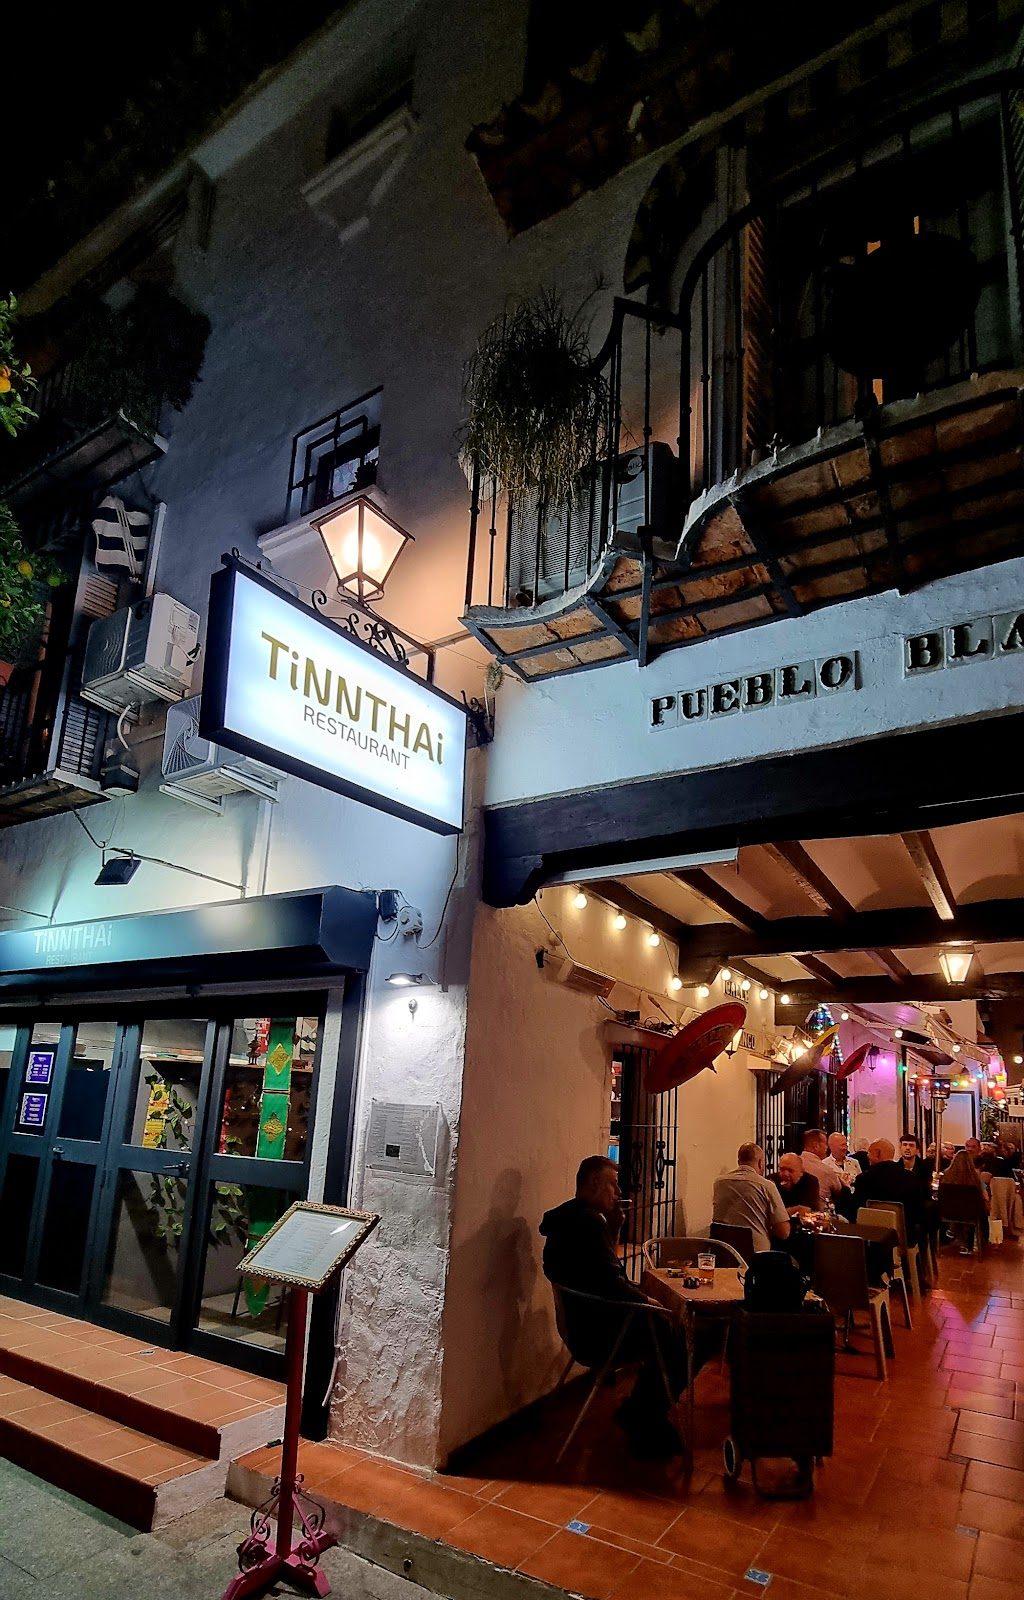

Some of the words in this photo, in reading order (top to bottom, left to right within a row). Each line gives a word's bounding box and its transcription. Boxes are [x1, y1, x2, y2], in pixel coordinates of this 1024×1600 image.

[261, 630, 444, 765] TiNNTHAi
[650, 655, 854, 727] PUEBLO
[303, 704, 411, 770] RESTAURANT
